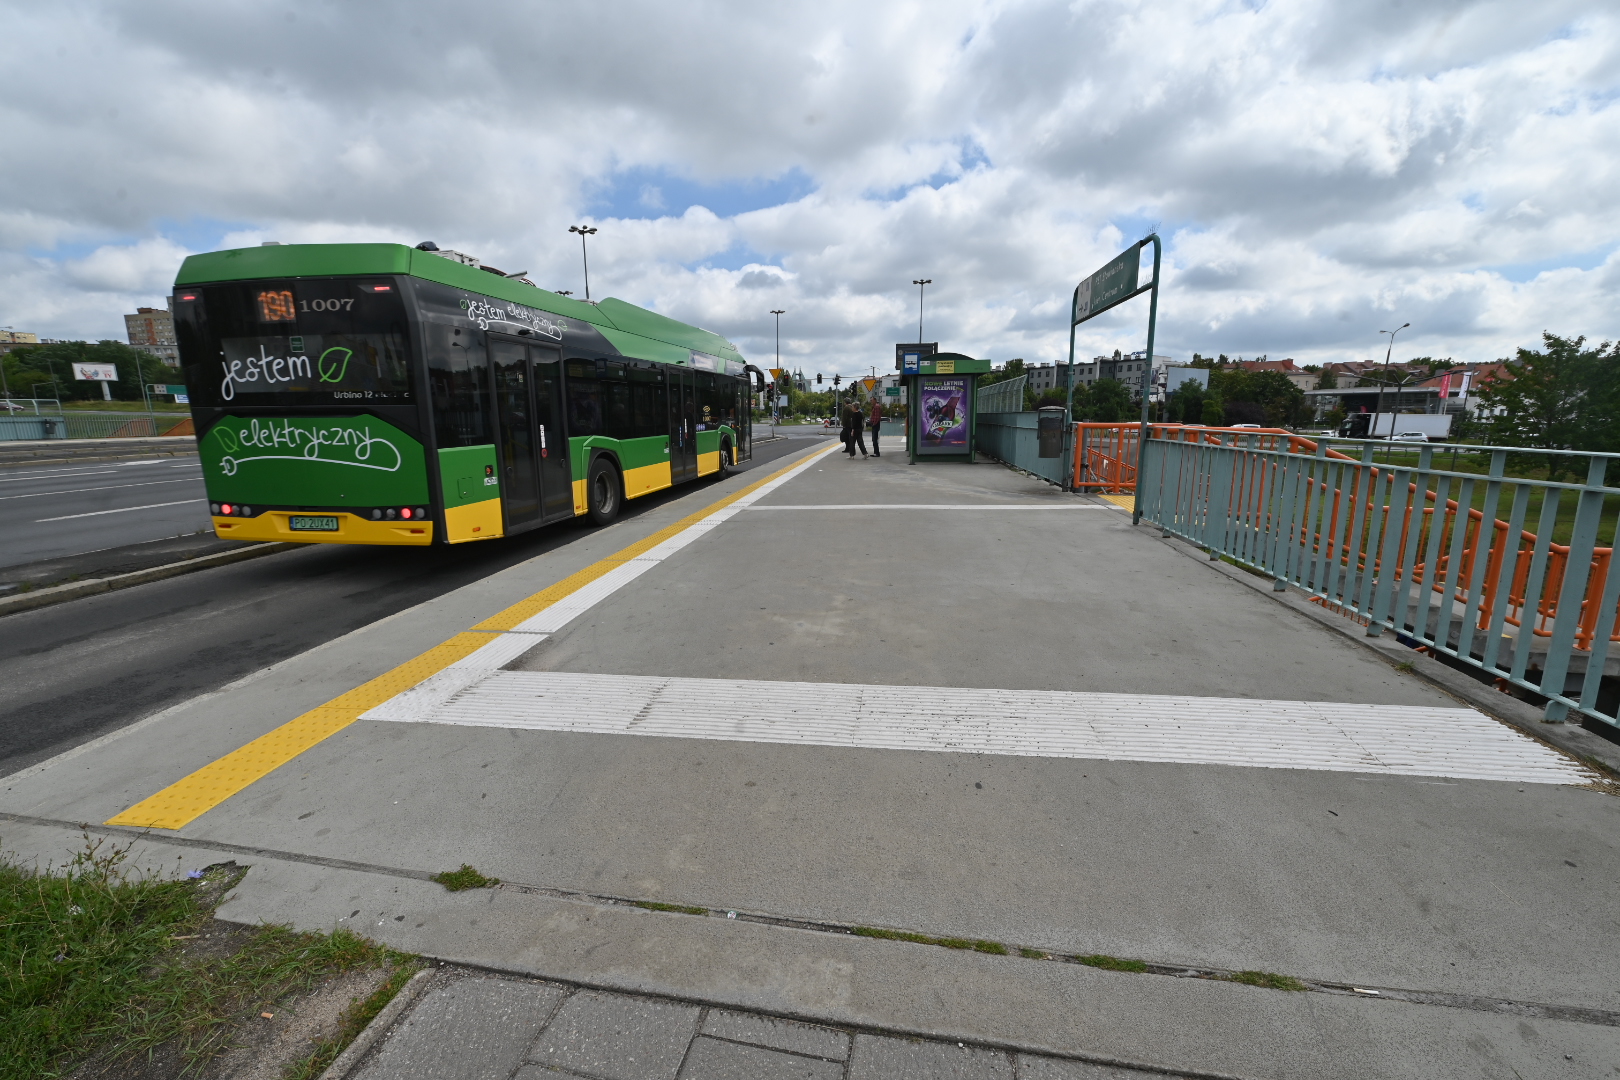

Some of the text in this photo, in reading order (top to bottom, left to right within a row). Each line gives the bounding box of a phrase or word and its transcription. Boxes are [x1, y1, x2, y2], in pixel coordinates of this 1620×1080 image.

[257, 290, 296, 321] 190
[299, 298, 355, 313] 1007
[465, 294, 554, 335] jestem elektryczny
[220, 345, 311, 400] jestem
[333, 391, 363, 399] Urbino
[363, 391, 373, 399] 12
[239, 418, 371, 460] elektryczny
[294, 518, 306, 528] PO
